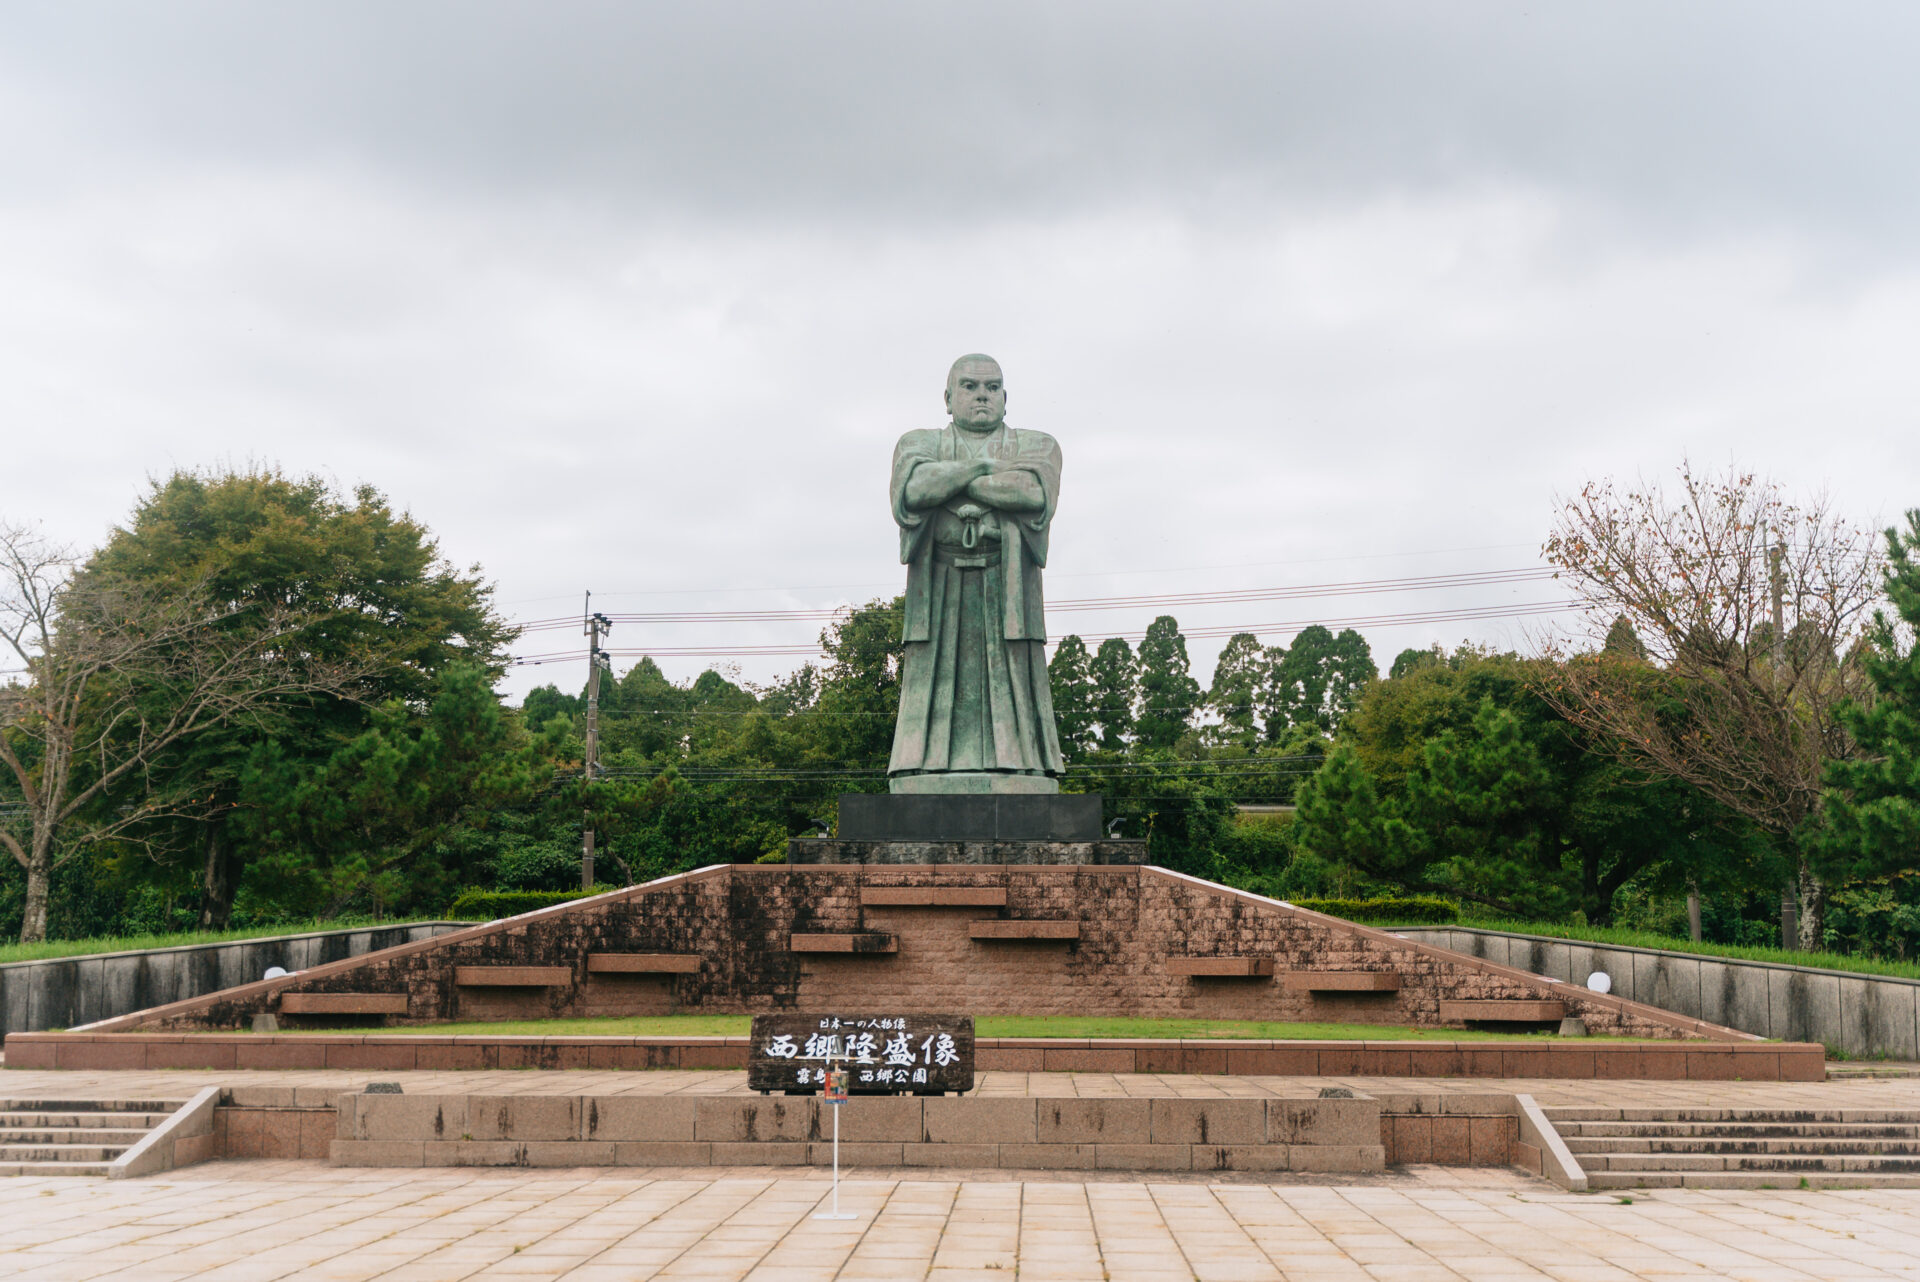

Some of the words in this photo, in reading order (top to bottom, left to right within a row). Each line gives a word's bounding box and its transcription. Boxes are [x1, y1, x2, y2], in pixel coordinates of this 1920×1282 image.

[819, 1017, 906, 1030] 日本一の人物像
[765, 1032, 961, 1067] 西郷隆盛像
[796, 1067, 848, 1084] 霧島
